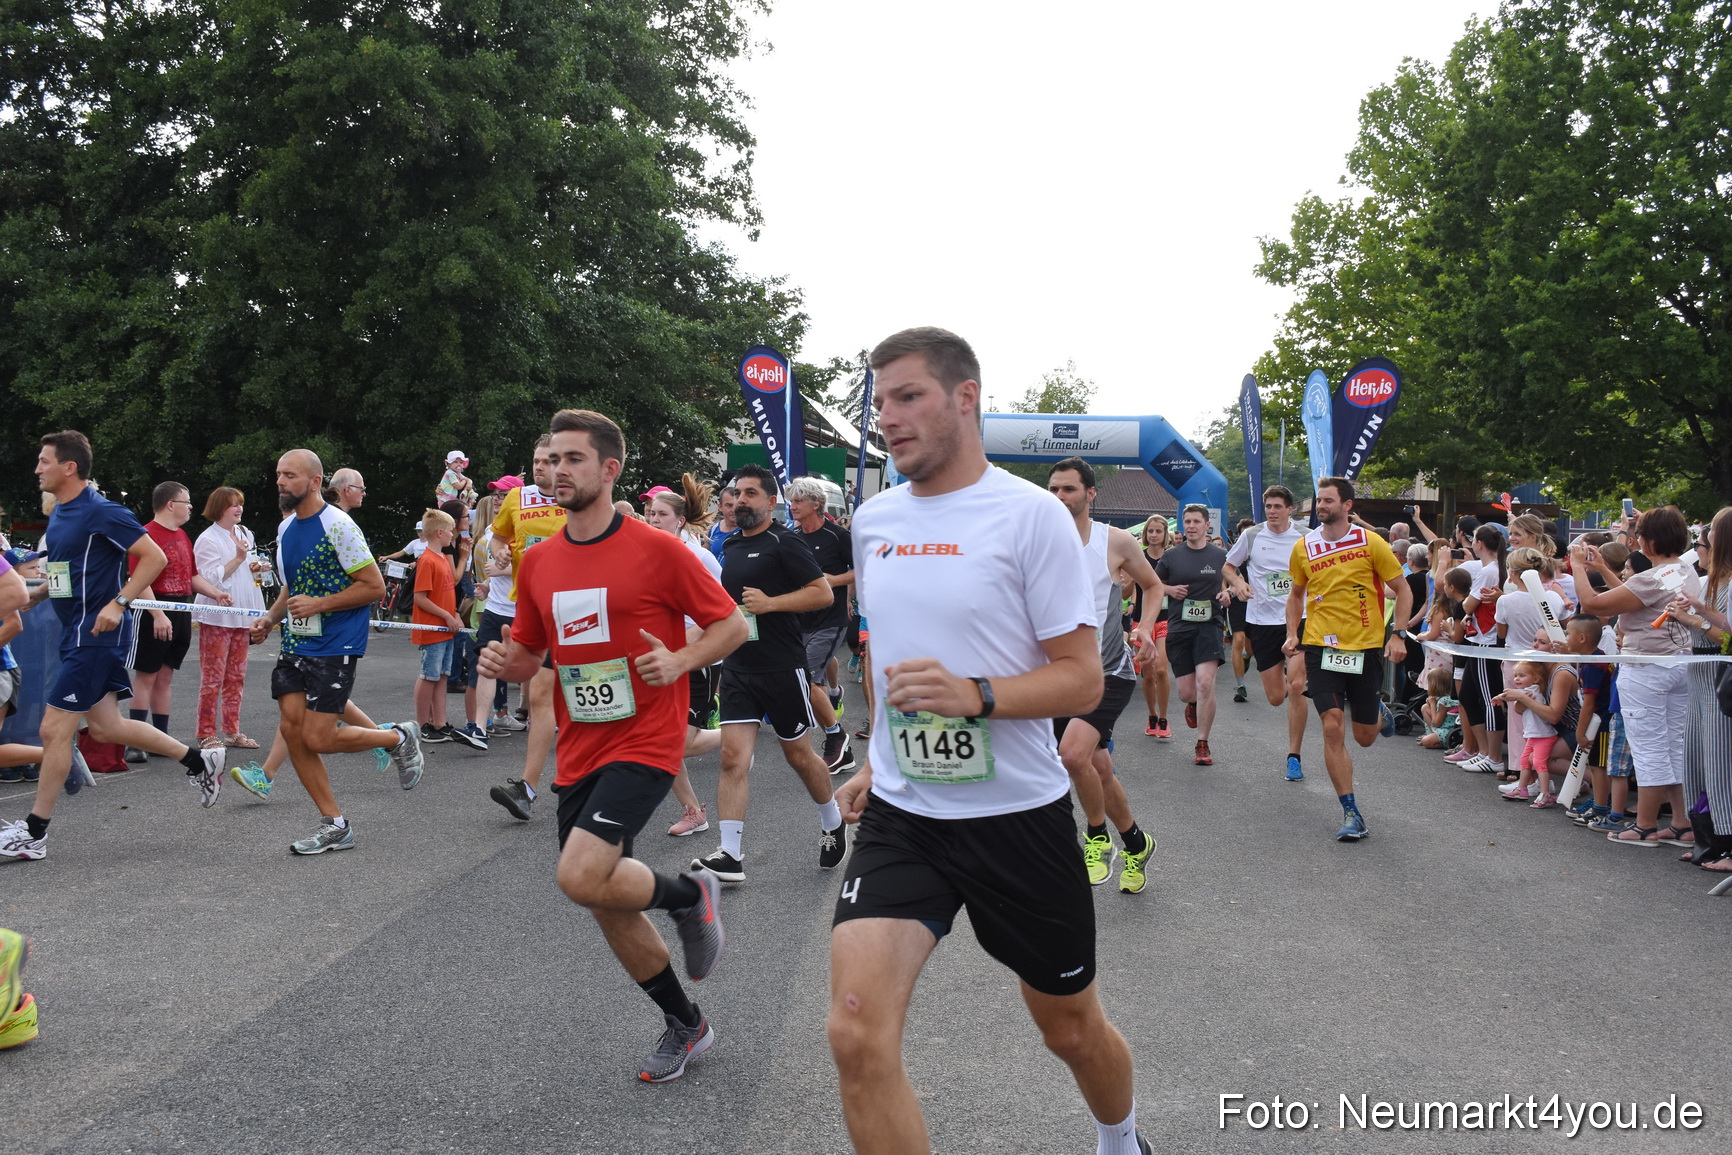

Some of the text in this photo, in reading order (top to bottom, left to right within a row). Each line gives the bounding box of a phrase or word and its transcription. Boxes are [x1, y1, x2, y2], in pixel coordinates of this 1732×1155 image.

[1350, 378, 1392, 398] Hervis
[1043, 439, 1100, 450] firmenlauf
[520, 510, 550, 521] MAX
[896, 544, 964, 556] KLEBL
[1310, 550, 1370, 573] MAX BÖGL
[1271, 580, 1292, 589] 146
[189, 606, 245, 616] Raiffeisenbank
[1541, 601, 1554, 620] swn
[1328, 654, 1357, 666] 1561
[575, 684, 613, 706] 539
[899, 729, 975, 760] 1148
[912, 760, 962, 769] Braun Daniel
[841, 877, 861, 903] 4
